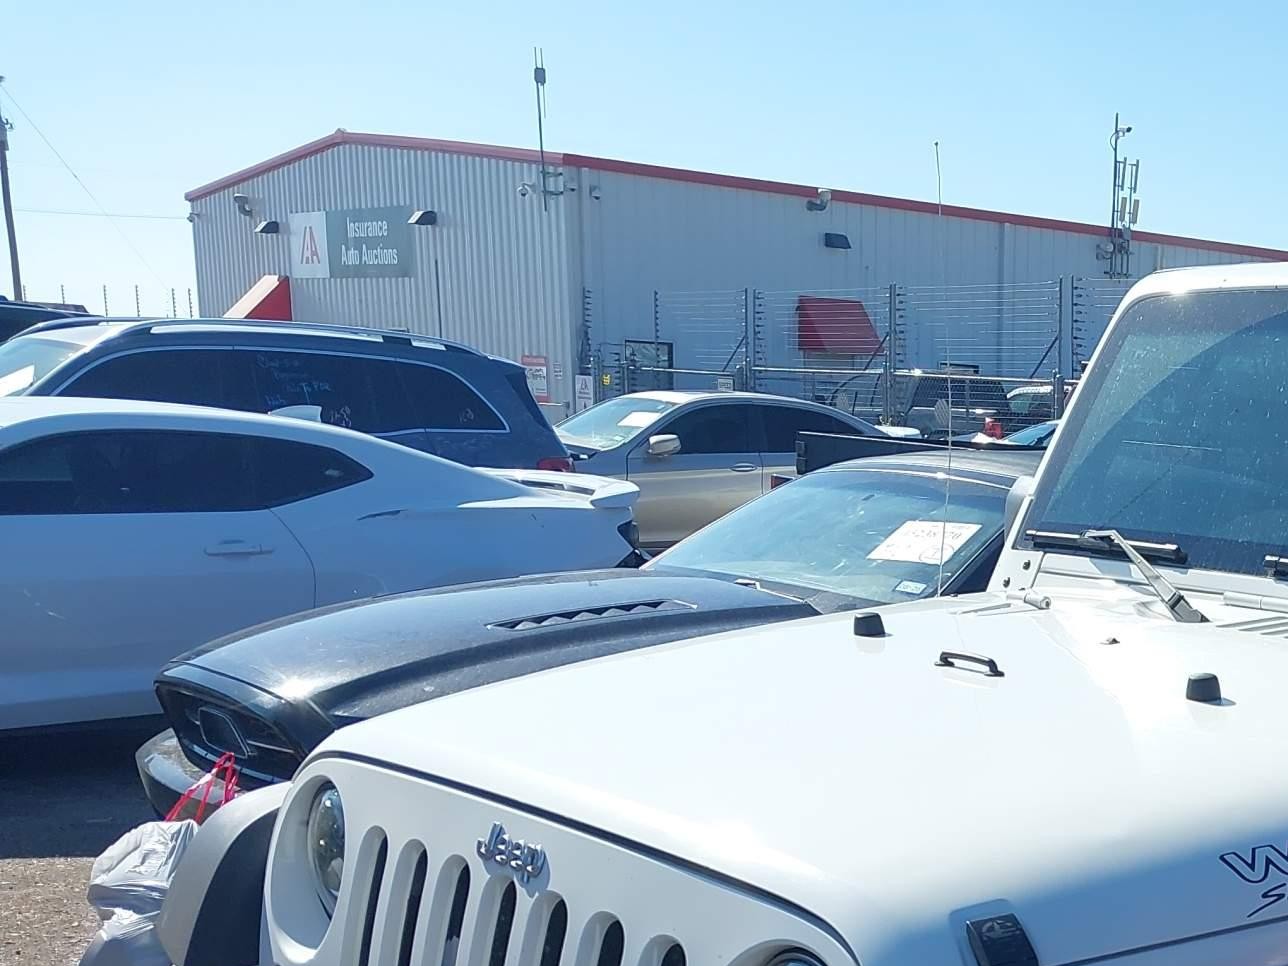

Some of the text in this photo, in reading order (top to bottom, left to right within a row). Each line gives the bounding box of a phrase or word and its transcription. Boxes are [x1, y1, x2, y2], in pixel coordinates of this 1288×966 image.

[346, 217, 388, 238] Insurance
[341, 243, 398, 266] Auto Auctions
[476, 821, 546, 884] Jeep
